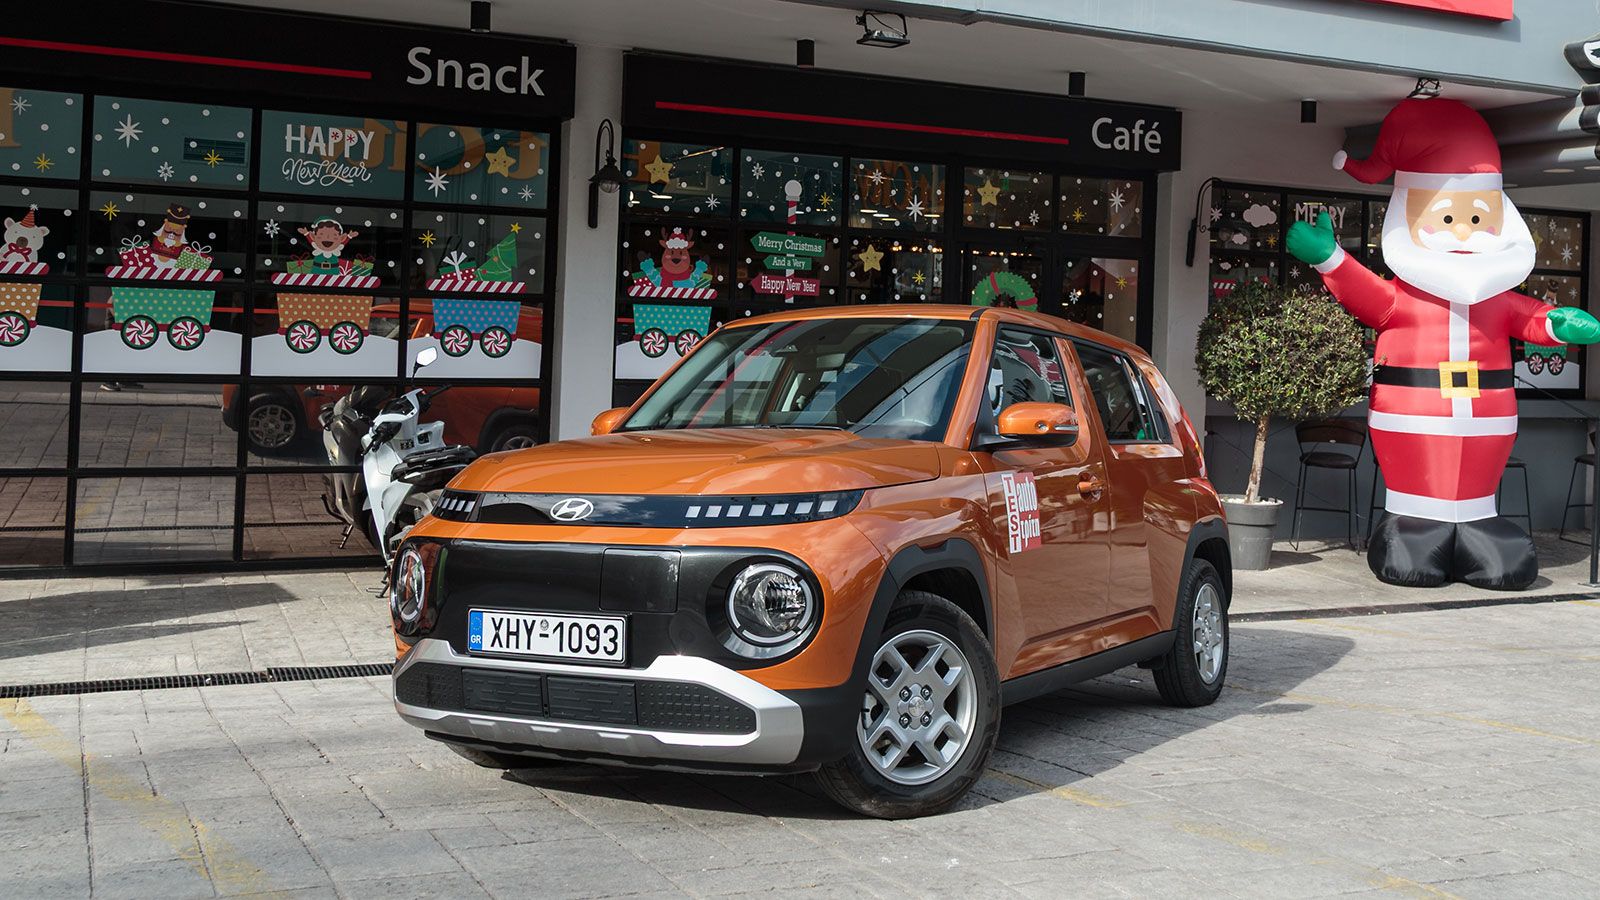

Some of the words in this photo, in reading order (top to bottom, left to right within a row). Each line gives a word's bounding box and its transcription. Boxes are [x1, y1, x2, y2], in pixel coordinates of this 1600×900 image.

[406, 46, 545, 97] Snack
[285, 123, 375, 161] HAPPY
[1091, 117, 1162, 153] Café
[282, 158, 330, 186] New
[319, 161, 372, 187] Year
[758, 236, 784, 251] Merry
[784, 239, 822, 253] Christmas
[772, 257, 786, 266] And
[792, 258, 806, 269] Very
[761, 275, 785, 294] Happy
[786, 278, 801, 291] New
[802, 280, 817, 293] Year
[1016, 476, 1038, 512] auto
[1003, 476, 1019, 551] TEST
[470, 634, 482, 645] GR
